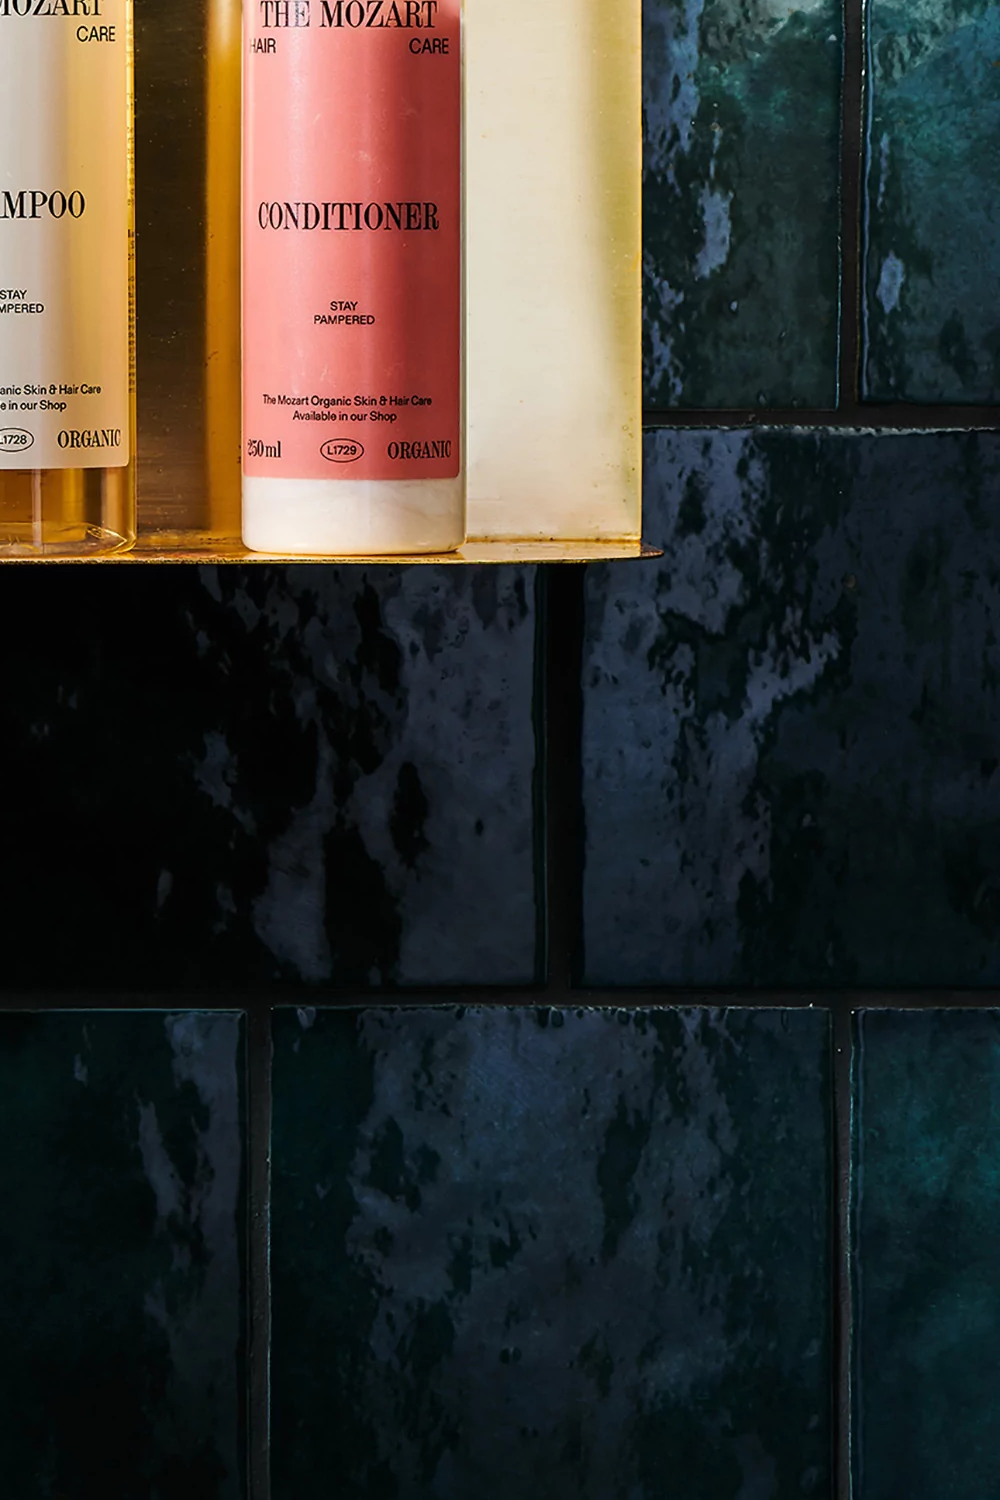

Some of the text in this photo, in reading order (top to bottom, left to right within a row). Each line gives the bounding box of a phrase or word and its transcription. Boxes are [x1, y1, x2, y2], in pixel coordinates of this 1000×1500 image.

[260, 0, 437, 28] THE MOZART
[76, 26, 116, 42] CARE
[250, 38, 449, 54] HAIR CARE
[258, 202, 439, 230] CONDITIONER
[0, 289, 27, 300] STAY
[330, 301, 358, 311] STAY
[313, 315, 375, 325] PAMPERED
[23, 384, 47, 395] Skin
[49, 384, 57, 395] &
[59, 384, 79, 395] Hair
[80, 384, 101, 395] Care
[8, 400, 18, 410] in
[20, 402, 38, 410] our
[39, 400, 67, 413] Shop
[263, 394, 432, 408] The Mozart Organic Skin & Hair Care
[293, 411, 397, 424] Available in our Shop
[57, 429, 121, 448] ORGANIC
[327, 446, 357, 456] L1729
[387, 440, 451, 460] ORGANIC
